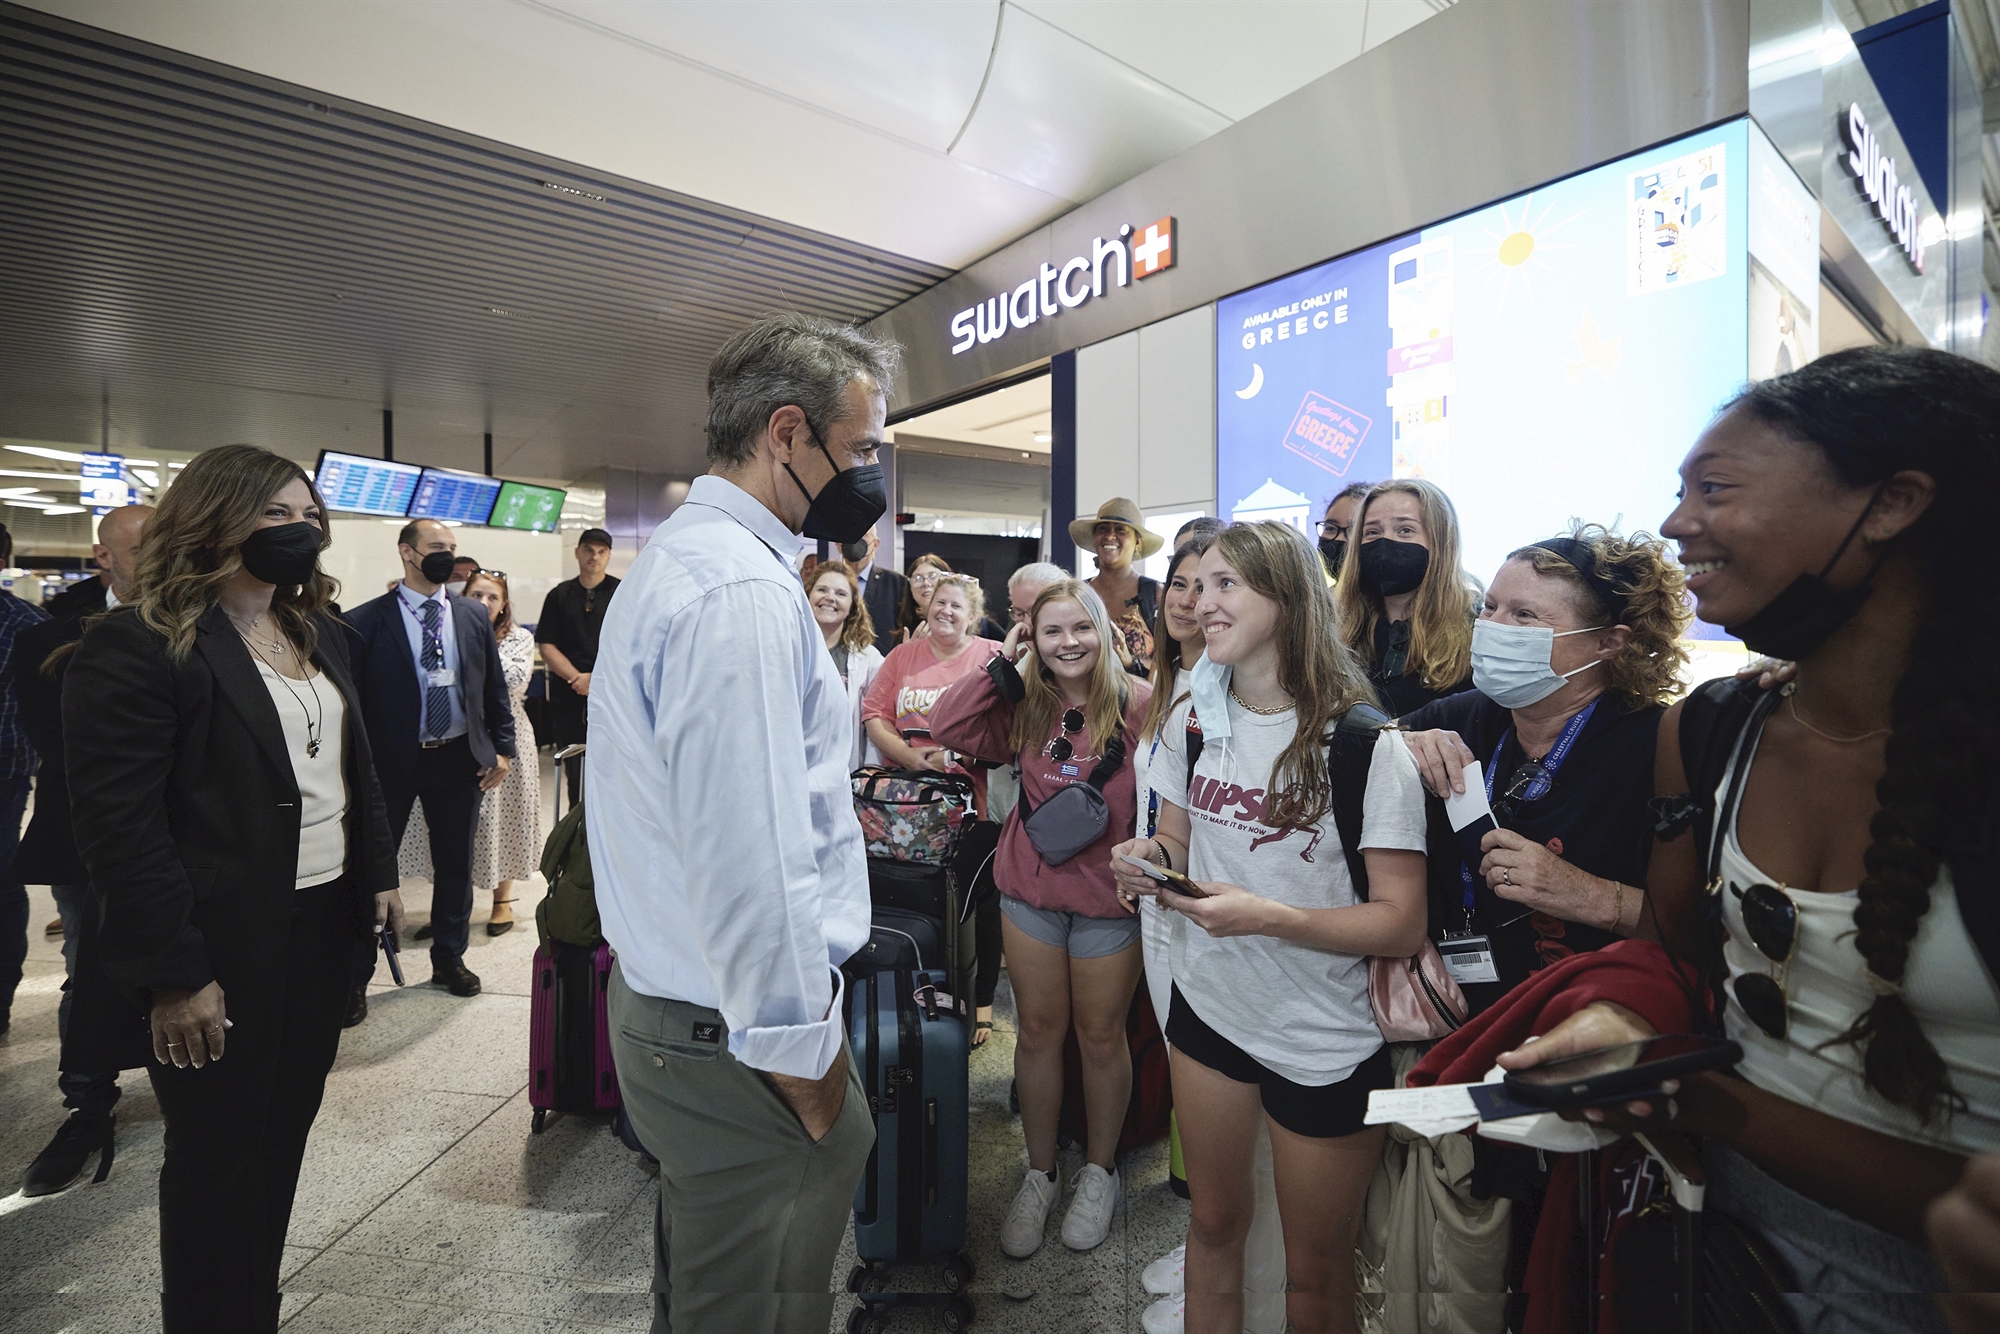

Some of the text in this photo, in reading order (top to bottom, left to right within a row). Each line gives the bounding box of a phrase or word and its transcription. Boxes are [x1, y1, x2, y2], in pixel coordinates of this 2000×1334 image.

[951, 235, 1130, 355] swatch
[1243, 287, 1348, 329] AVAILABLE ONLY IN
[1242, 304, 1348, 350] GREECE
[1295, 414, 1355, 459] GREECE
[1567, 714, 1583, 735] CRUISES
[1200, 813, 1208, 821] TO
[1209, 816, 1229, 827] MAKE
[1230, 821, 1237, 829] IT
[1248, 827, 1267, 836] NOW
